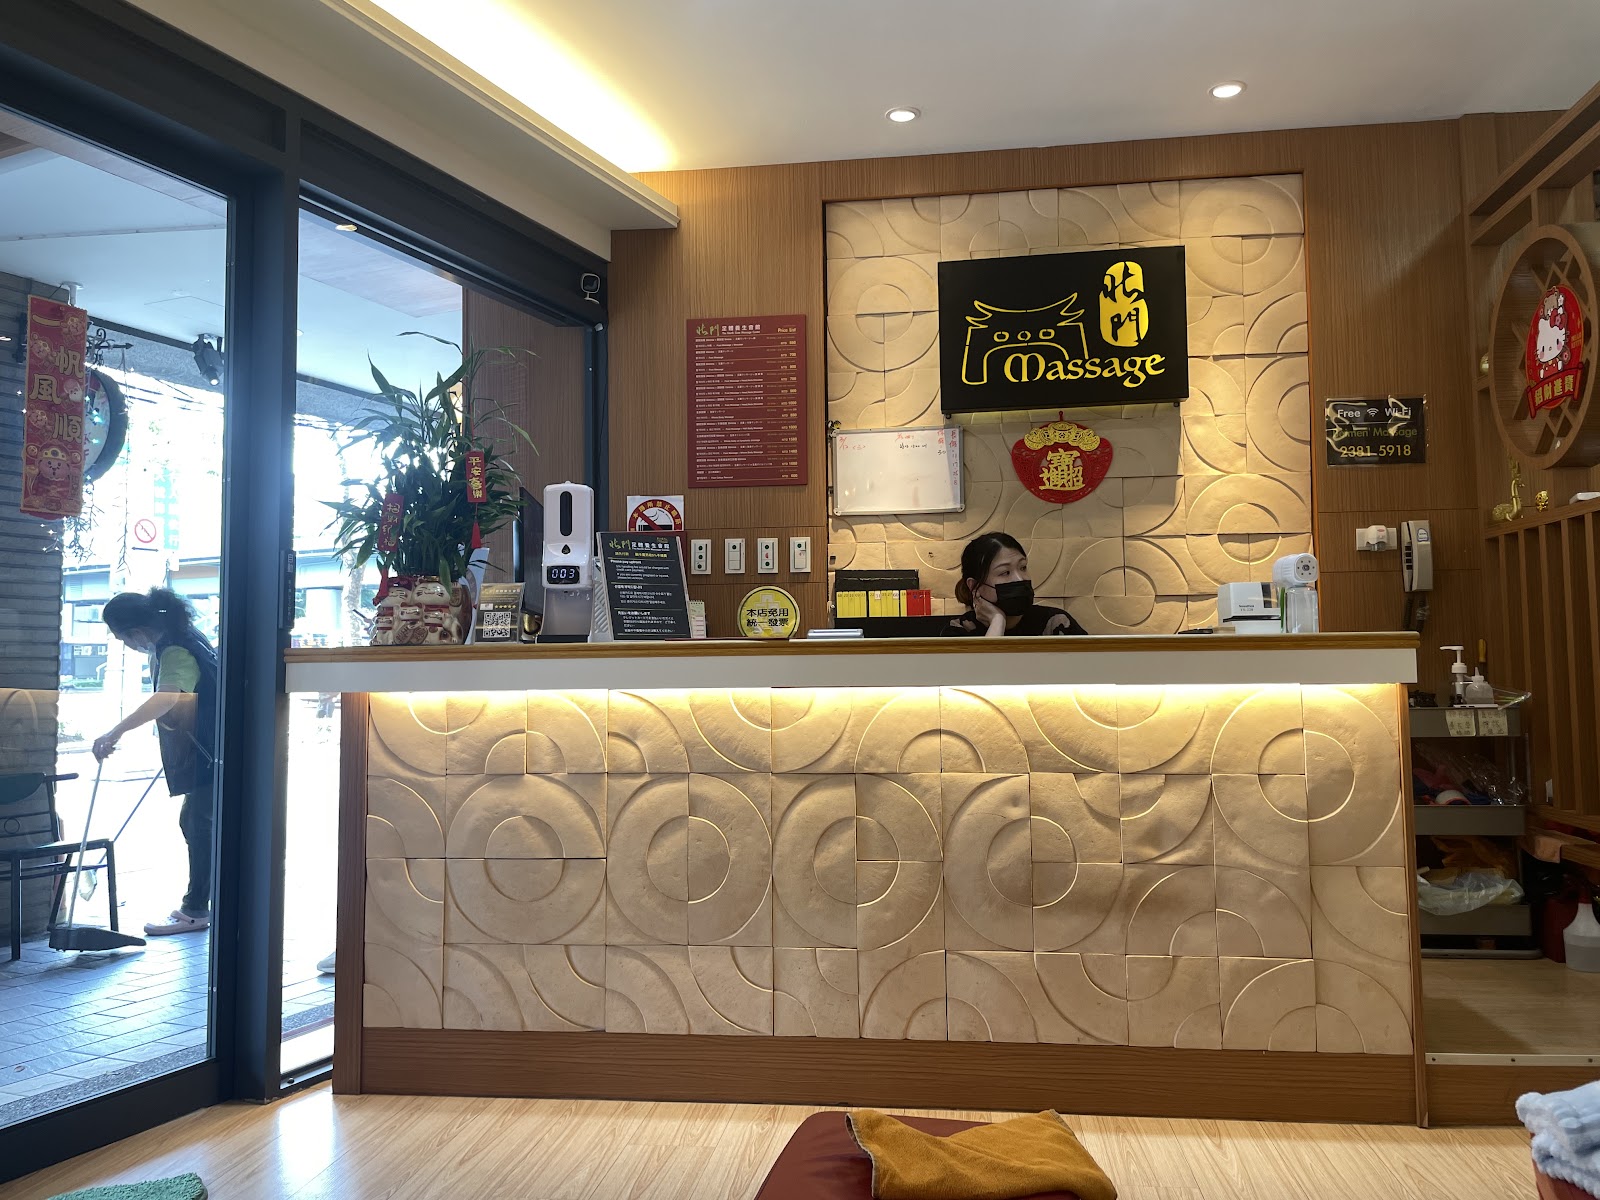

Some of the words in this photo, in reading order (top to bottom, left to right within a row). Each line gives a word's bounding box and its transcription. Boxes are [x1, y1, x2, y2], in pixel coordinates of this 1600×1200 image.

[1004, 352, 1166, 389] Massage
[29, 314, 84, 444] 一帆風順
[1534, 374, 1575, 407] 招財進寶
[1337, 409, 1361, 418] Free
[1373, 427, 1417, 438] Masage
[1340, 445, 1371, 458] 2381
[1378, 444, 1412, 457] 5918
[551, 568, 575, 579] 003
[746, 608, 789, 618] 本店免用
[746, 618, 790, 627] 統一發票
